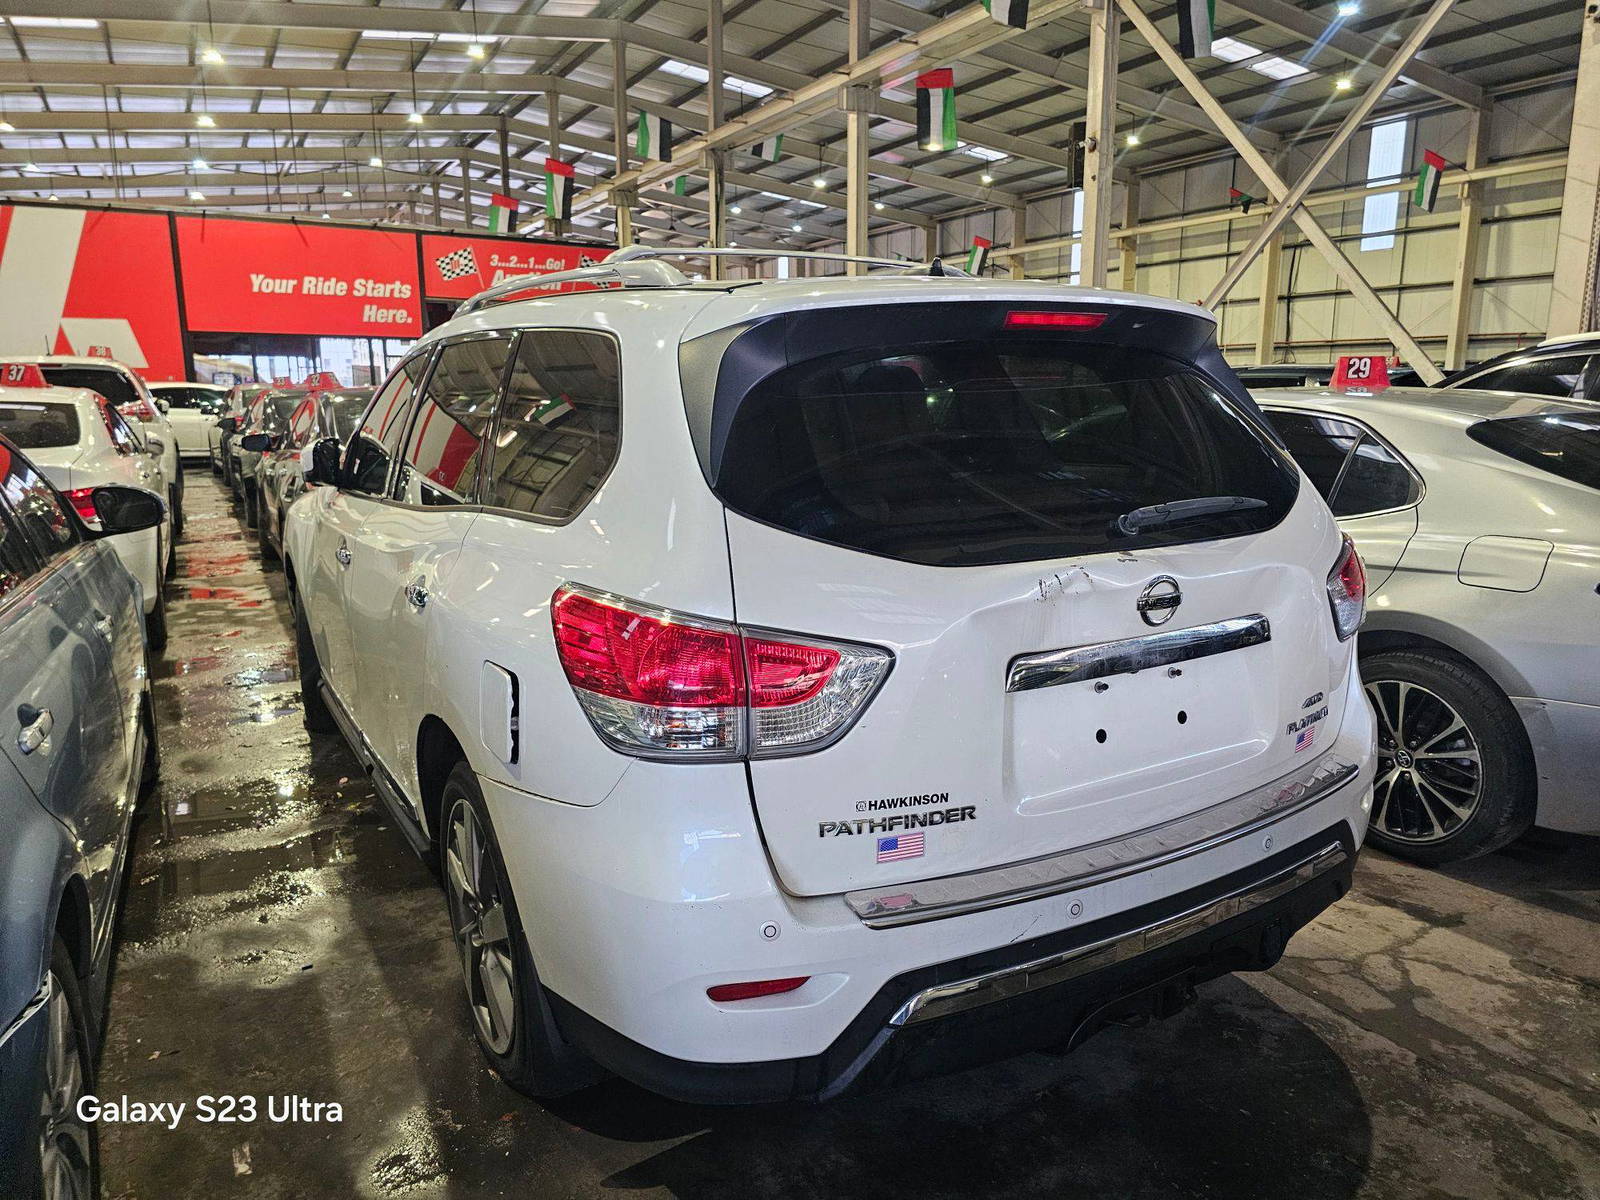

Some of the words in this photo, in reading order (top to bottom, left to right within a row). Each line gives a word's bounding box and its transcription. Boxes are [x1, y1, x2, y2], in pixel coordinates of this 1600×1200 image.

[250, 273, 298, 294] Your
[302, 276, 348, 296] Ride
[353, 278, 412, 299] Starts
[362, 304, 413, 324] Here.
[8, 365, 25, 381] 37
[1347, 357, 1371, 379] 29
[868, 792, 949, 811] HAWKINSON
[818, 805, 977, 838] PATHFINDER
